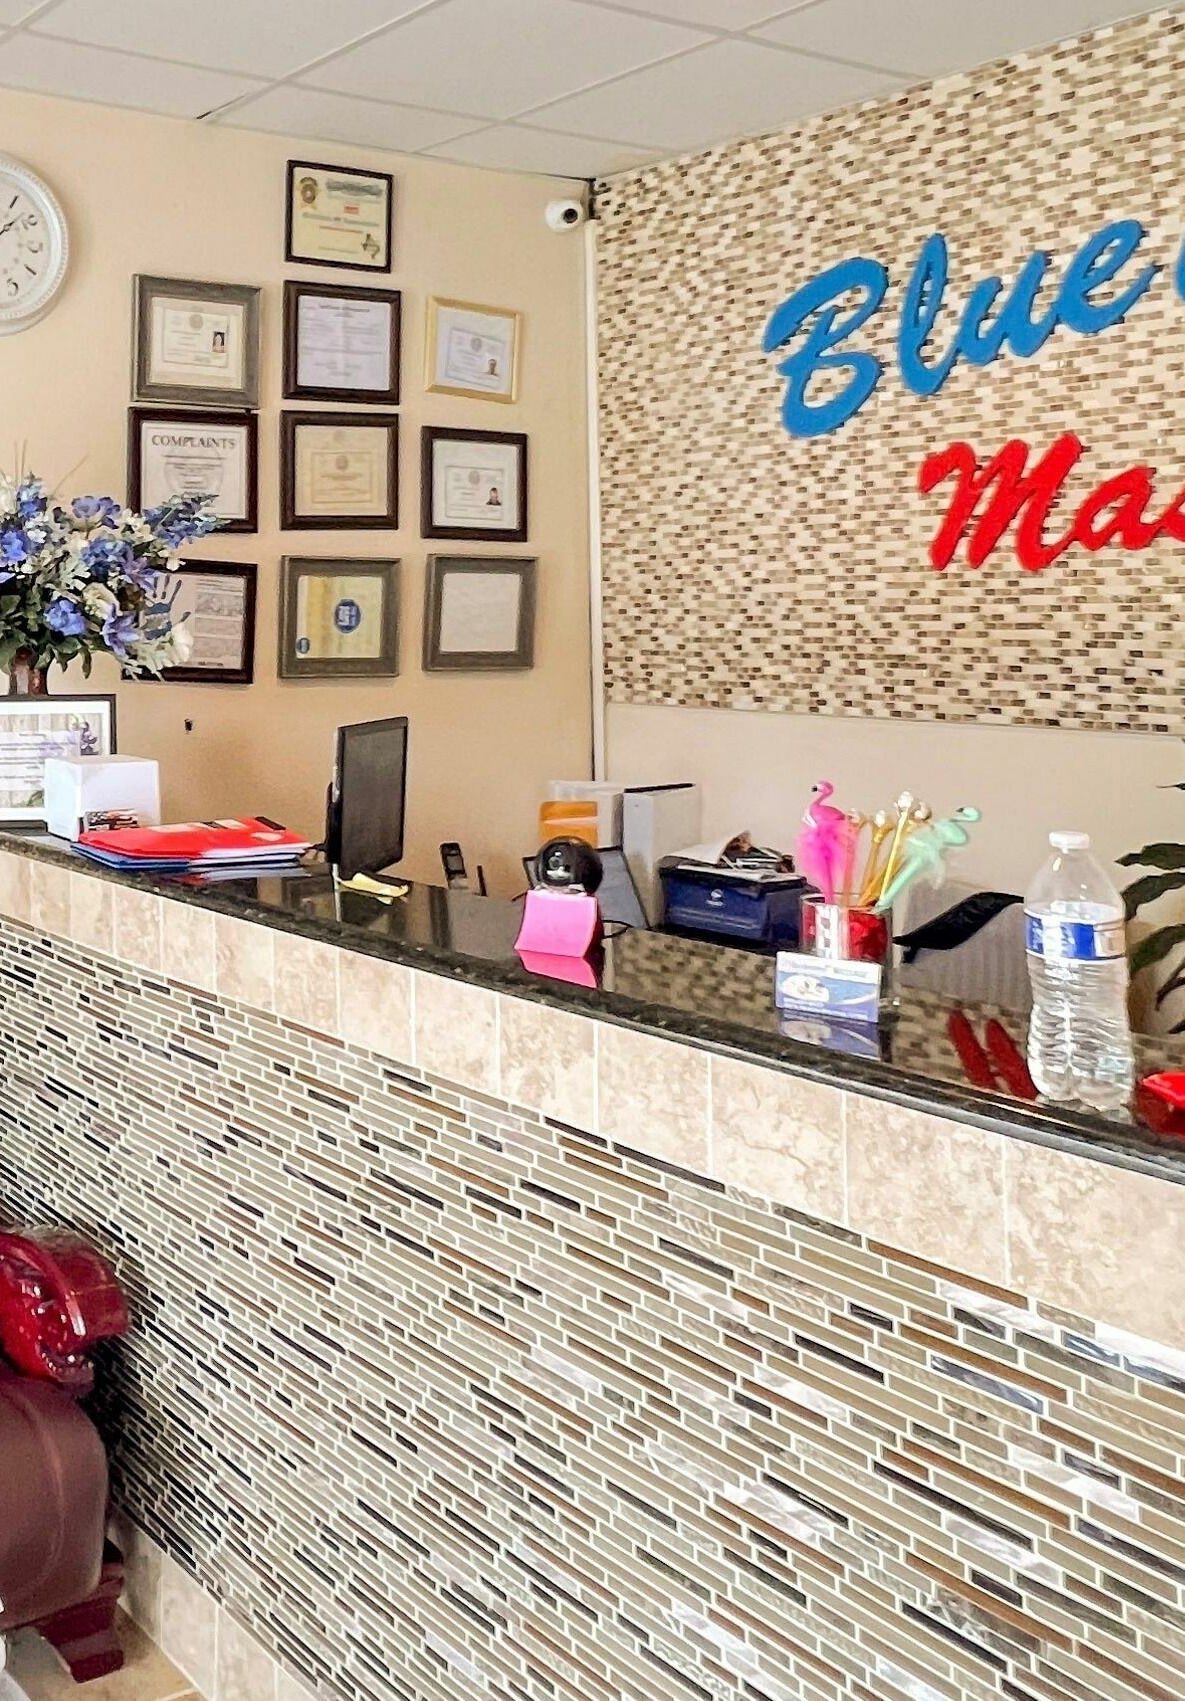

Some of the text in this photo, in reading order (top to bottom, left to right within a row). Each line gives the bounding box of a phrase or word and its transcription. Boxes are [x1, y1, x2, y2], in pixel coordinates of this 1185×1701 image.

[9, 195, 19, 209] 1
[21, 214, 38, 231] 2
[6, 278, 19, 297] 5
[763, 219, 1161, 438] Blue
[151, 434, 237, 450] COMPLAINTS
